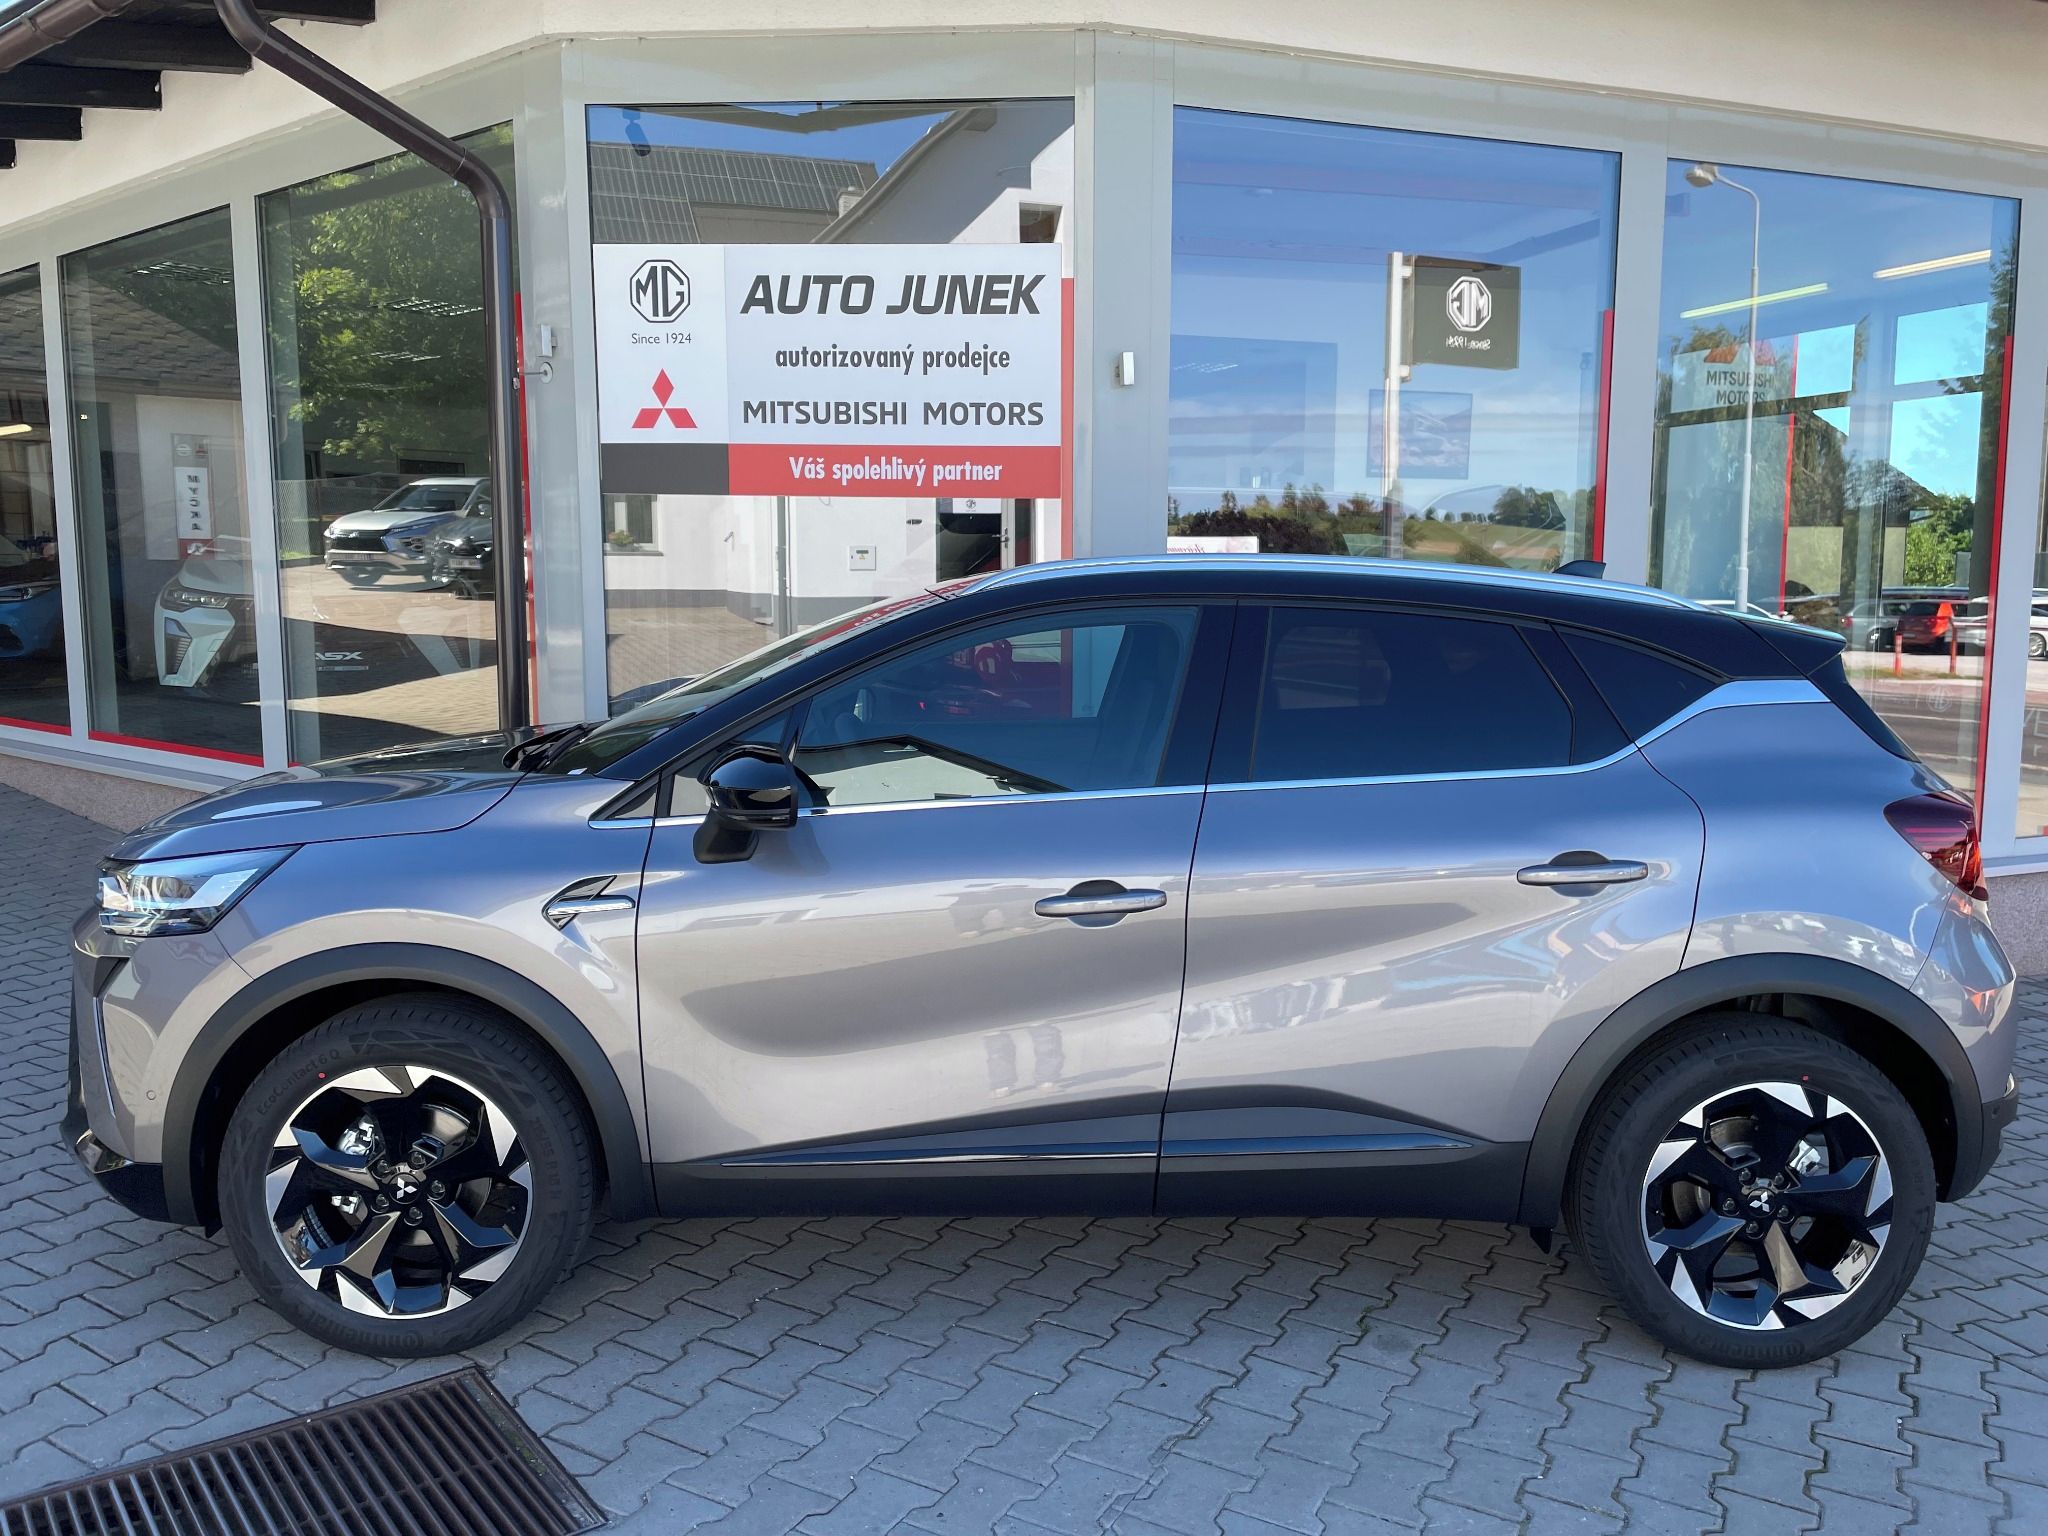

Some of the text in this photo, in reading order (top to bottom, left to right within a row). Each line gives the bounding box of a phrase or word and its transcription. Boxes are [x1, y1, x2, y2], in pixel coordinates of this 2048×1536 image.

[632, 263, 688, 320] MG
[740, 274, 1046, 315] AUTO JUNEK
[631, 332, 692, 345] Since 1924
[775, 342, 1011, 376] autorizovaný prodejce
[743, 400, 1045, 426] MITSUBISHI MOTORS
[789, 456, 1003, 487] Váš spolehlivý partner
[256, 1059, 318, 1116] EcoContact
